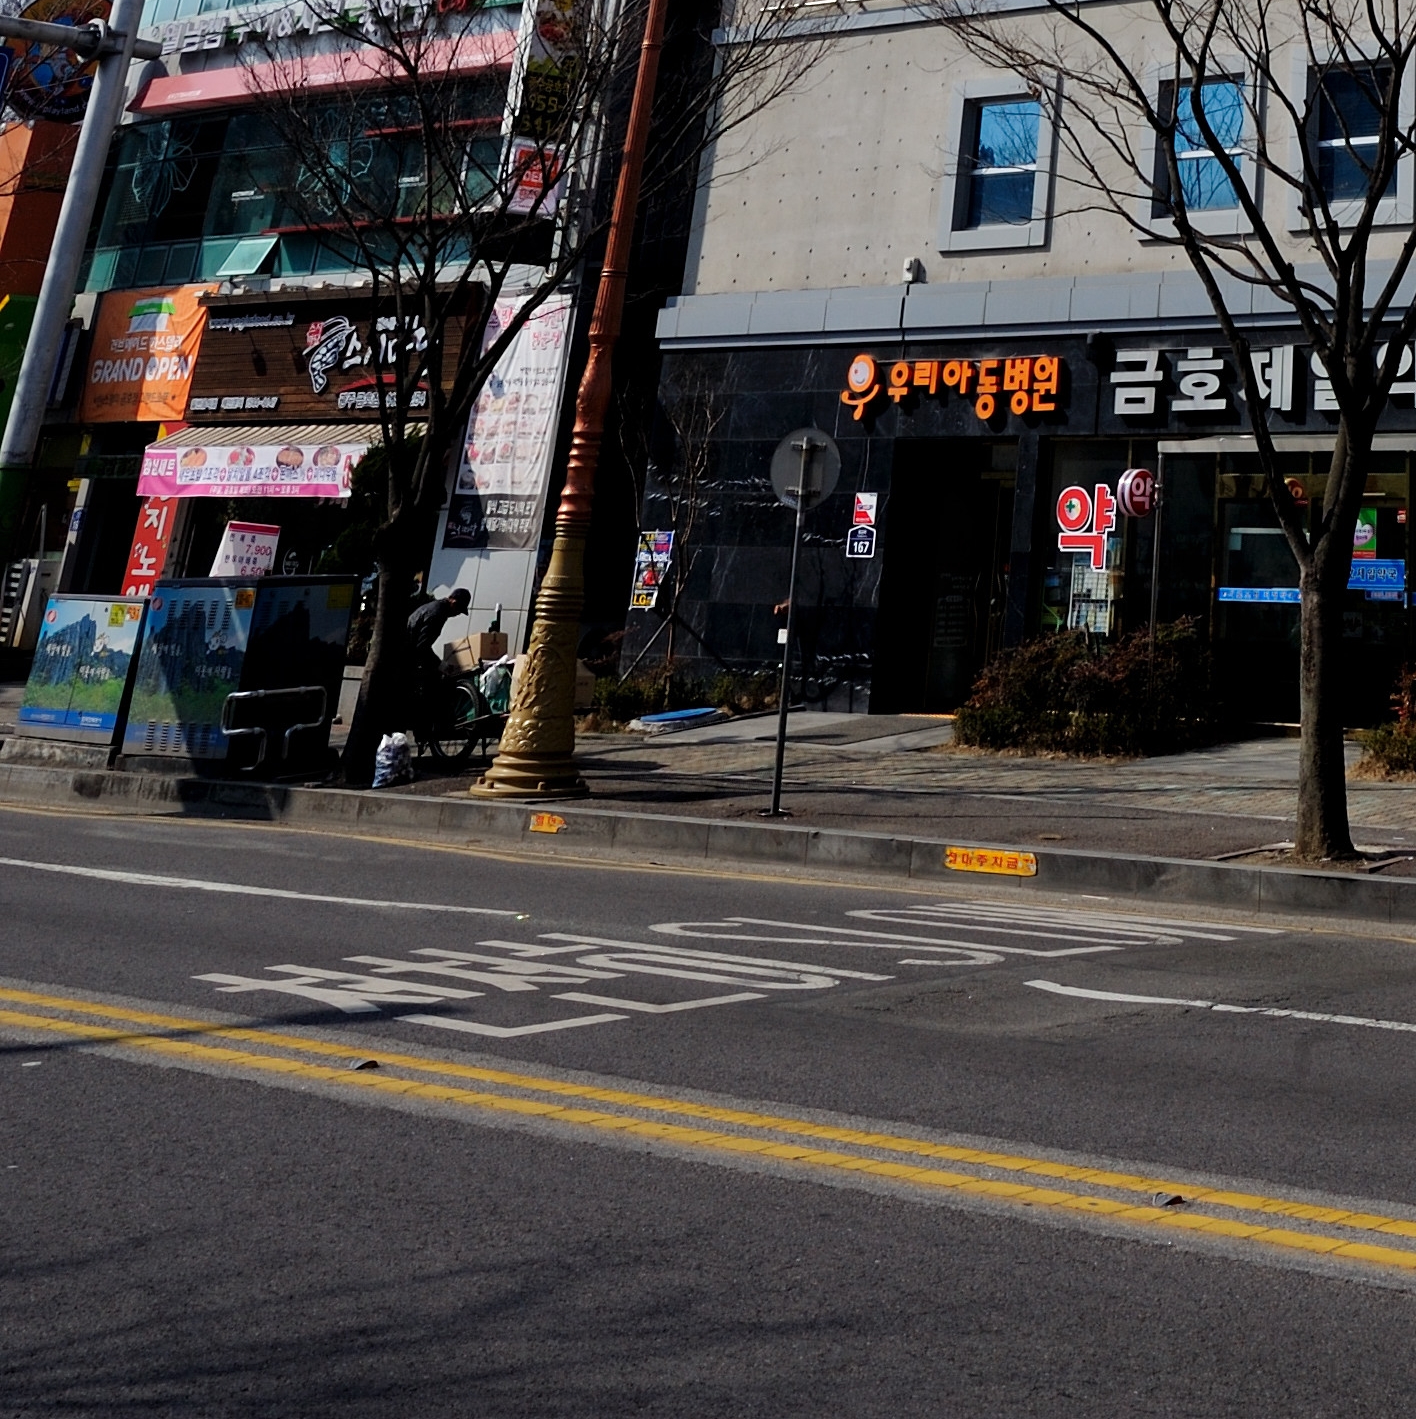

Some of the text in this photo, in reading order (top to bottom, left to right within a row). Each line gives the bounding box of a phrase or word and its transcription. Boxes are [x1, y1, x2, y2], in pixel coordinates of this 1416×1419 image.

[91, 354, 193, 384] GRAND OPEN
[887, 356, 1060, 421] 우리아동병원
[1131, 477, 1154, 511] 약
[1057, 484, 1117, 573] 약
[853, 540, 870, 554] 167
